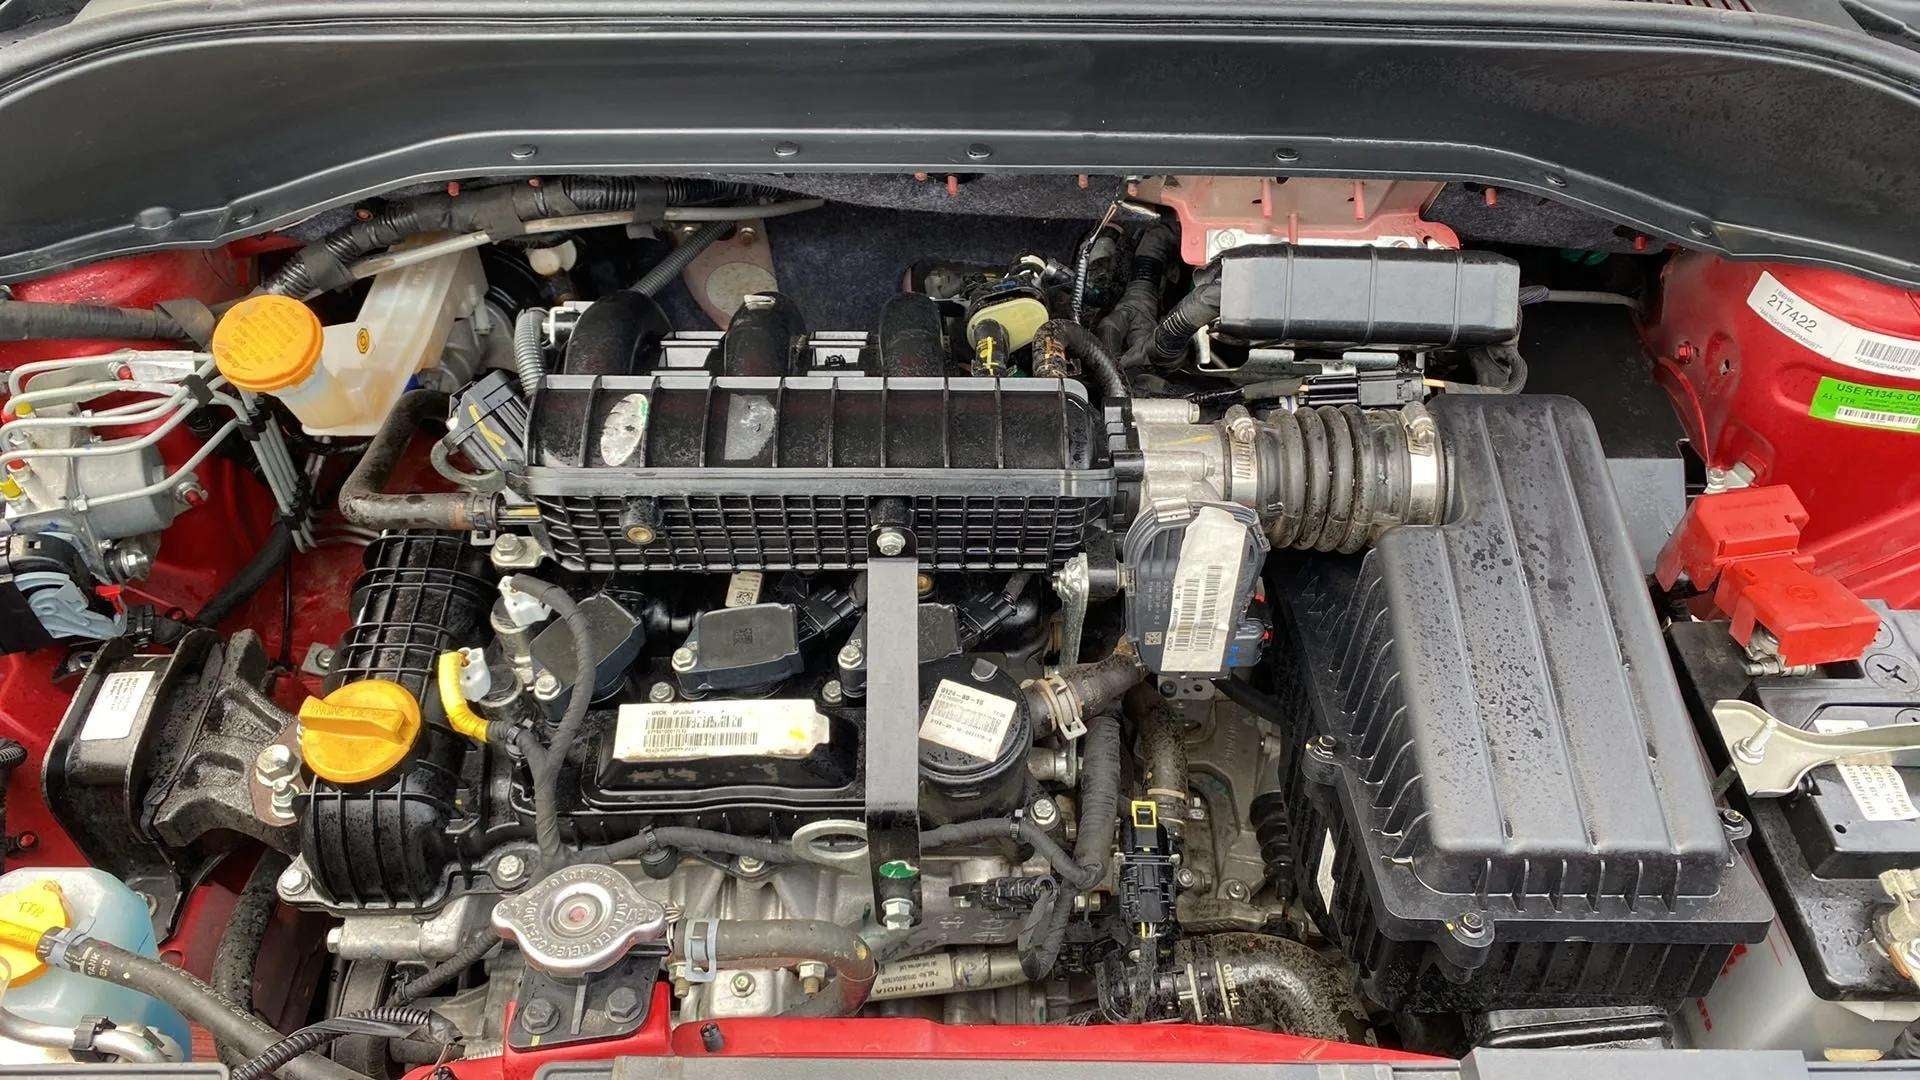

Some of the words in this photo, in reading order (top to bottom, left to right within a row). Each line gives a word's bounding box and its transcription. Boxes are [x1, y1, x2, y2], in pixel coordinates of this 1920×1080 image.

[1766, 294, 1819, 333] 217422
[1836, 383, 1862, 396] USE
[1864, 387, 1904, 400] R134-a
[875, 985, 907, 994] INDIA
[911, 981, 935, 991] FIAT
